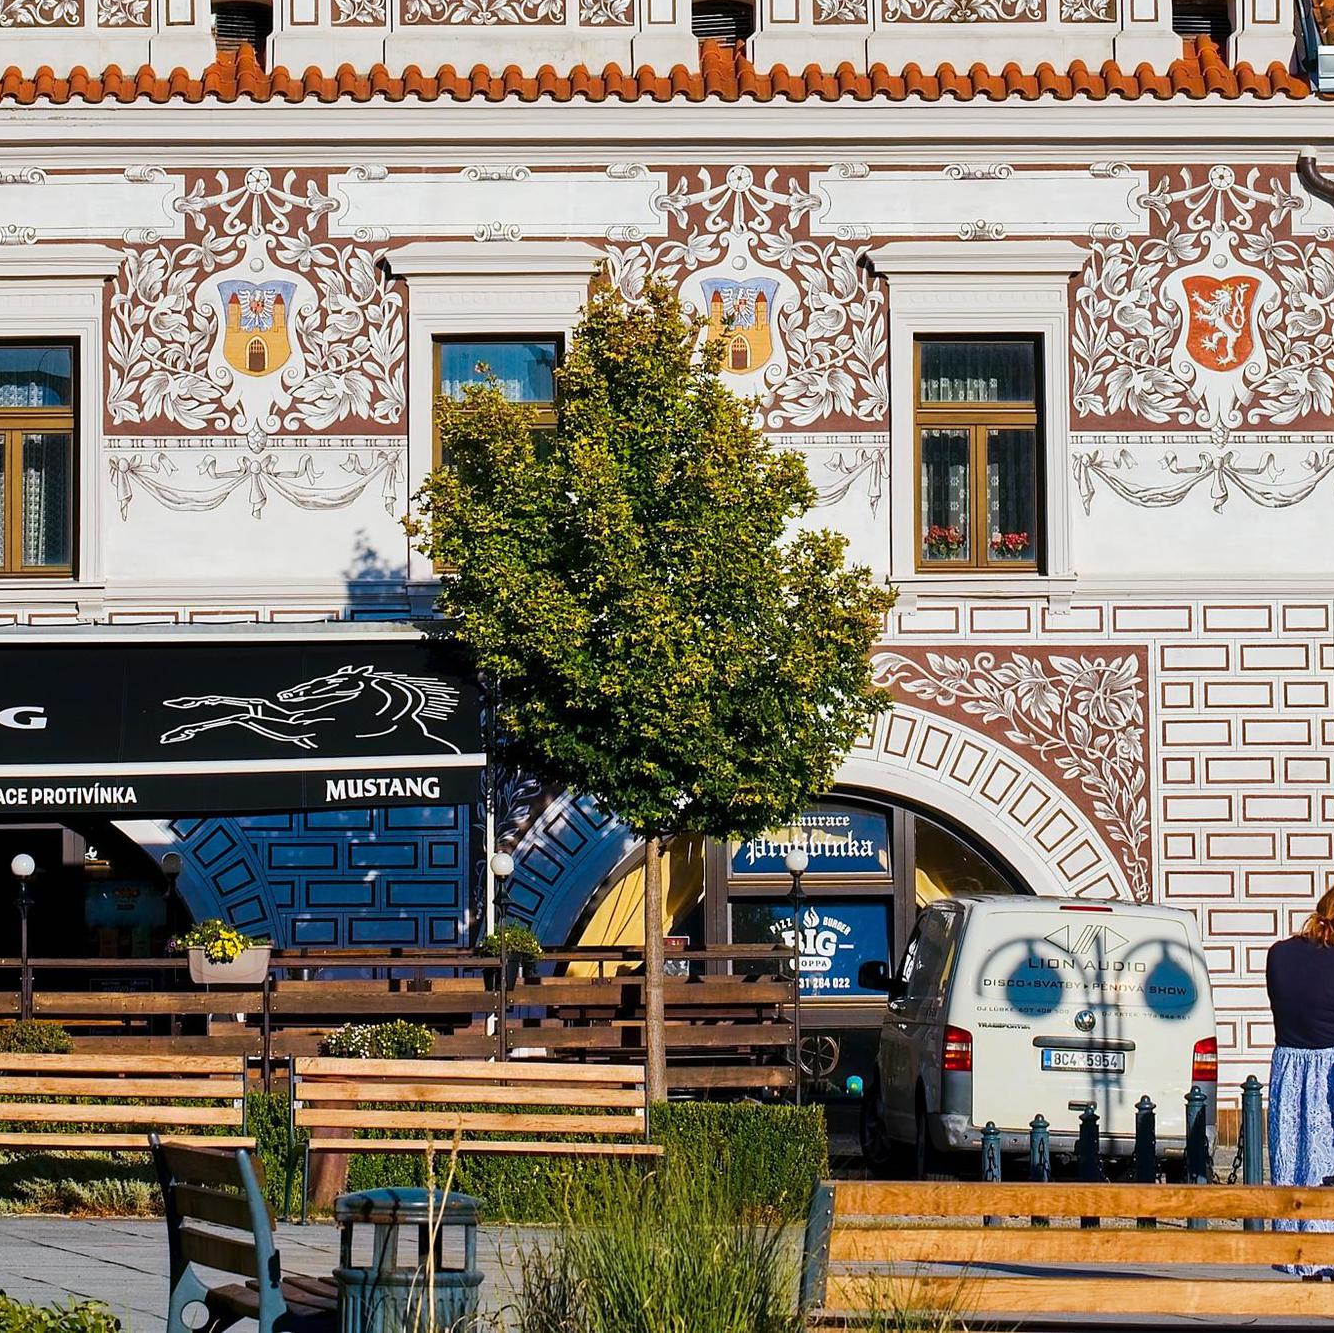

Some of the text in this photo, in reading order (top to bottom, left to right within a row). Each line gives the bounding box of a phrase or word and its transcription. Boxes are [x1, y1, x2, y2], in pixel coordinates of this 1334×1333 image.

[31, 782, 138, 805] PROTIVÍNKA
[325, 777, 441, 802] MUSTANG
[769, 916, 853, 936] PIZZ BURGER
[793, 959, 828, 968] OPPA
[1028, 957, 1147, 973] LION AUDIO
[832, 977, 851, 988] 022
[983, 978, 1025, 987] DISCO
[1149, 985, 1187, 996] SHOW
[1053, 1052, 1118, 1068] 8C4 5954
